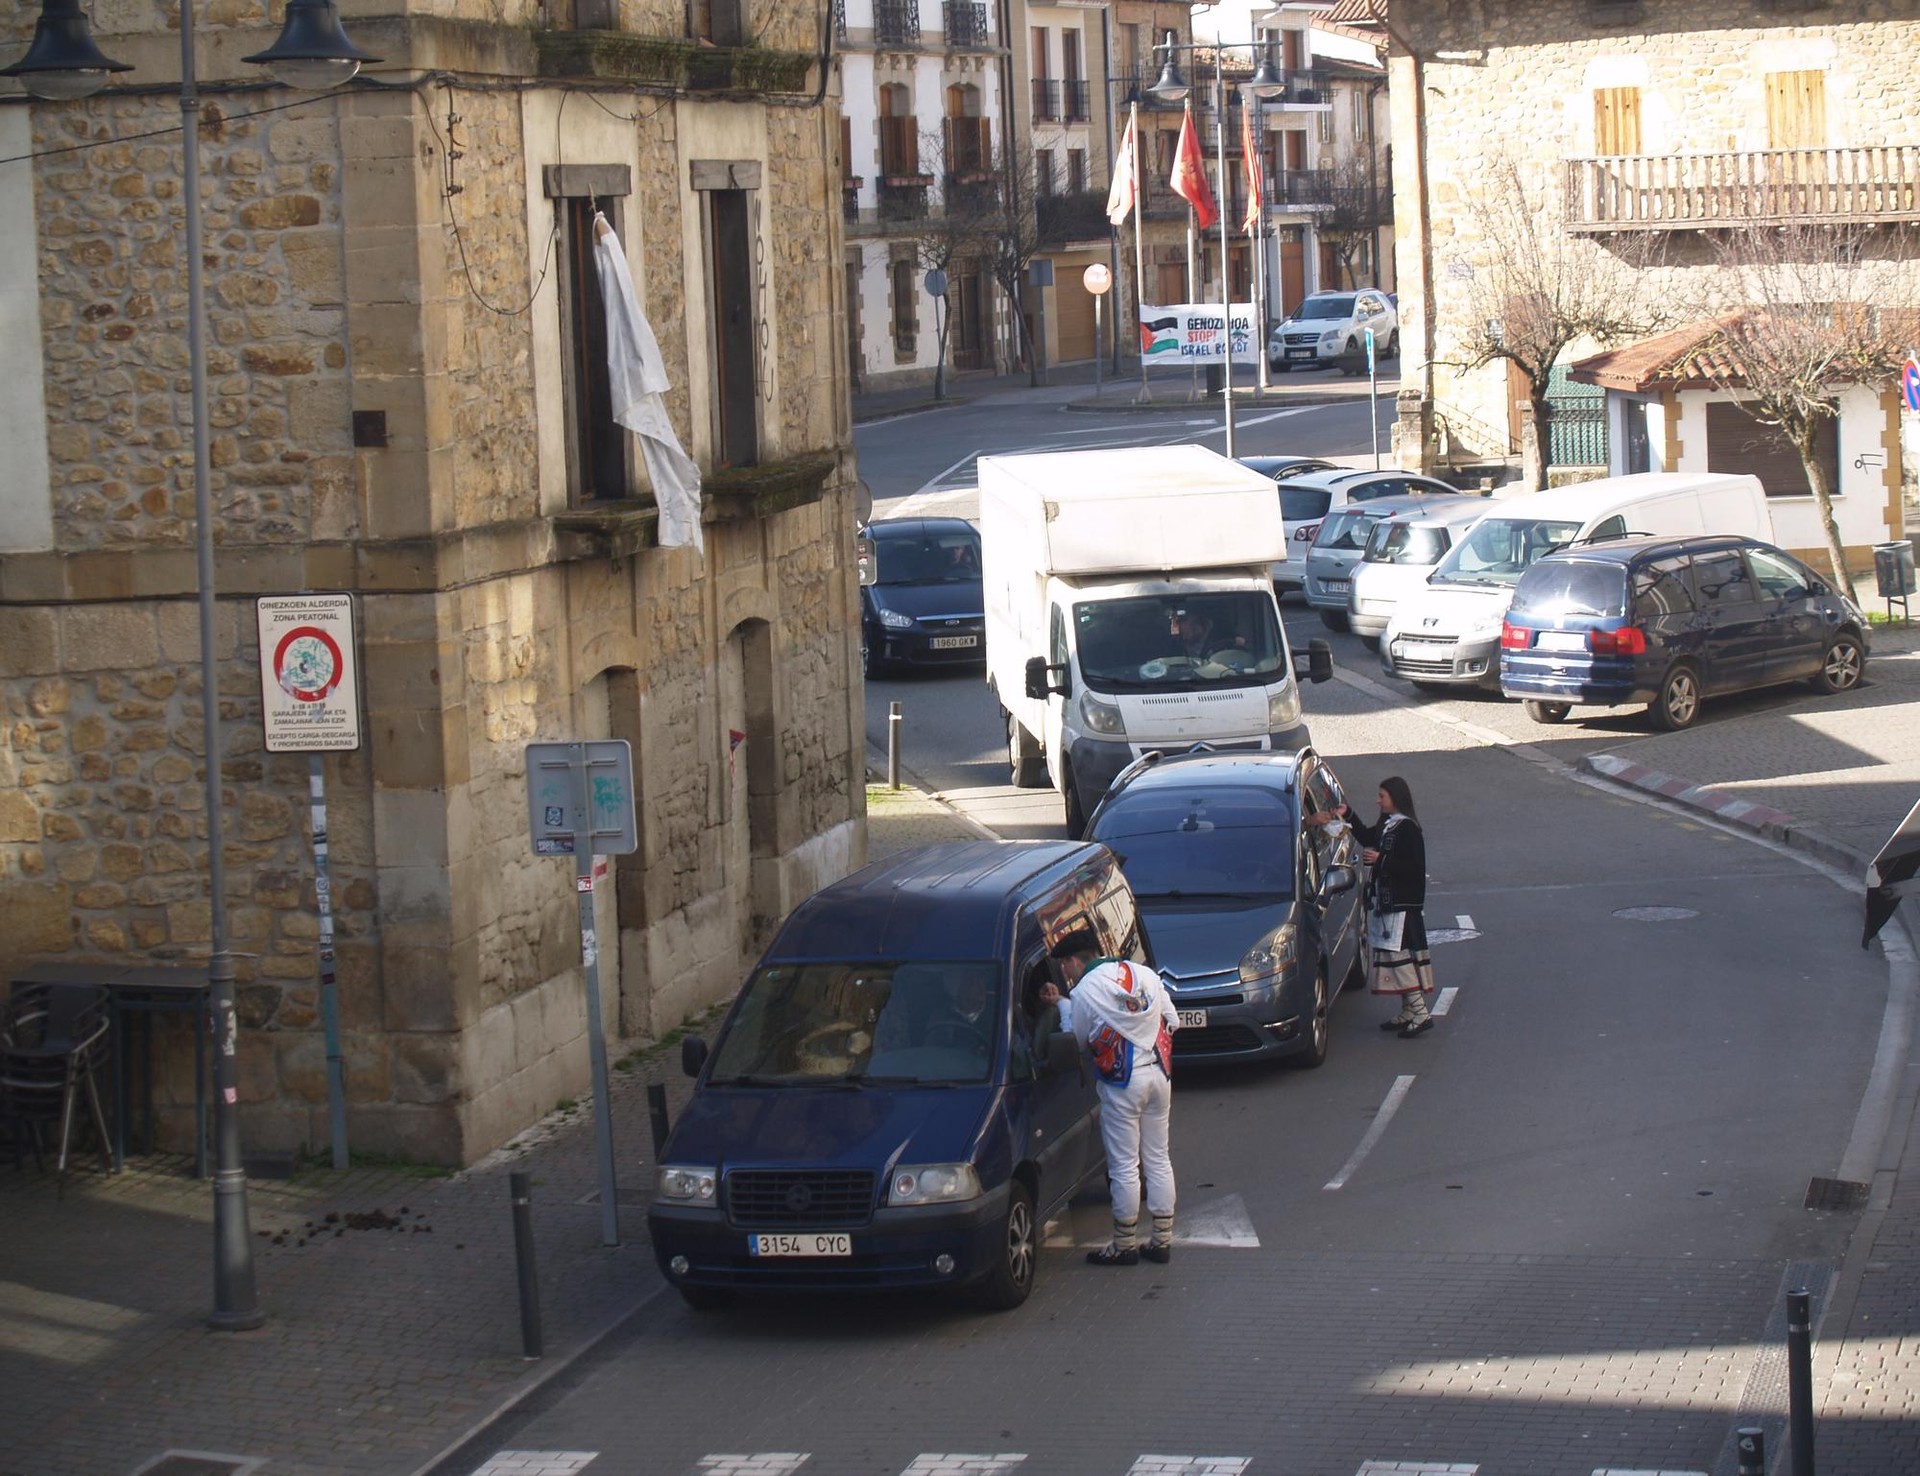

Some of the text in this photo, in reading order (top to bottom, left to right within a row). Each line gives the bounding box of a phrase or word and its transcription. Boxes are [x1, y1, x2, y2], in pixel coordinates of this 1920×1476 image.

[1187, 317, 1249, 330] GENOZIIOA
[1188, 331, 1216, 343] STOP!
[1181, 342, 1249, 356] ISRAEL BOKOT
[260, 600, 349, 609] OINEZKOEN ALDERDIA
[273, 613, 340, 622] ZONA PEATONAL
[937, 638, 957, 648] 1960
[760, 1236, 847, 1253] 3154 CYC
